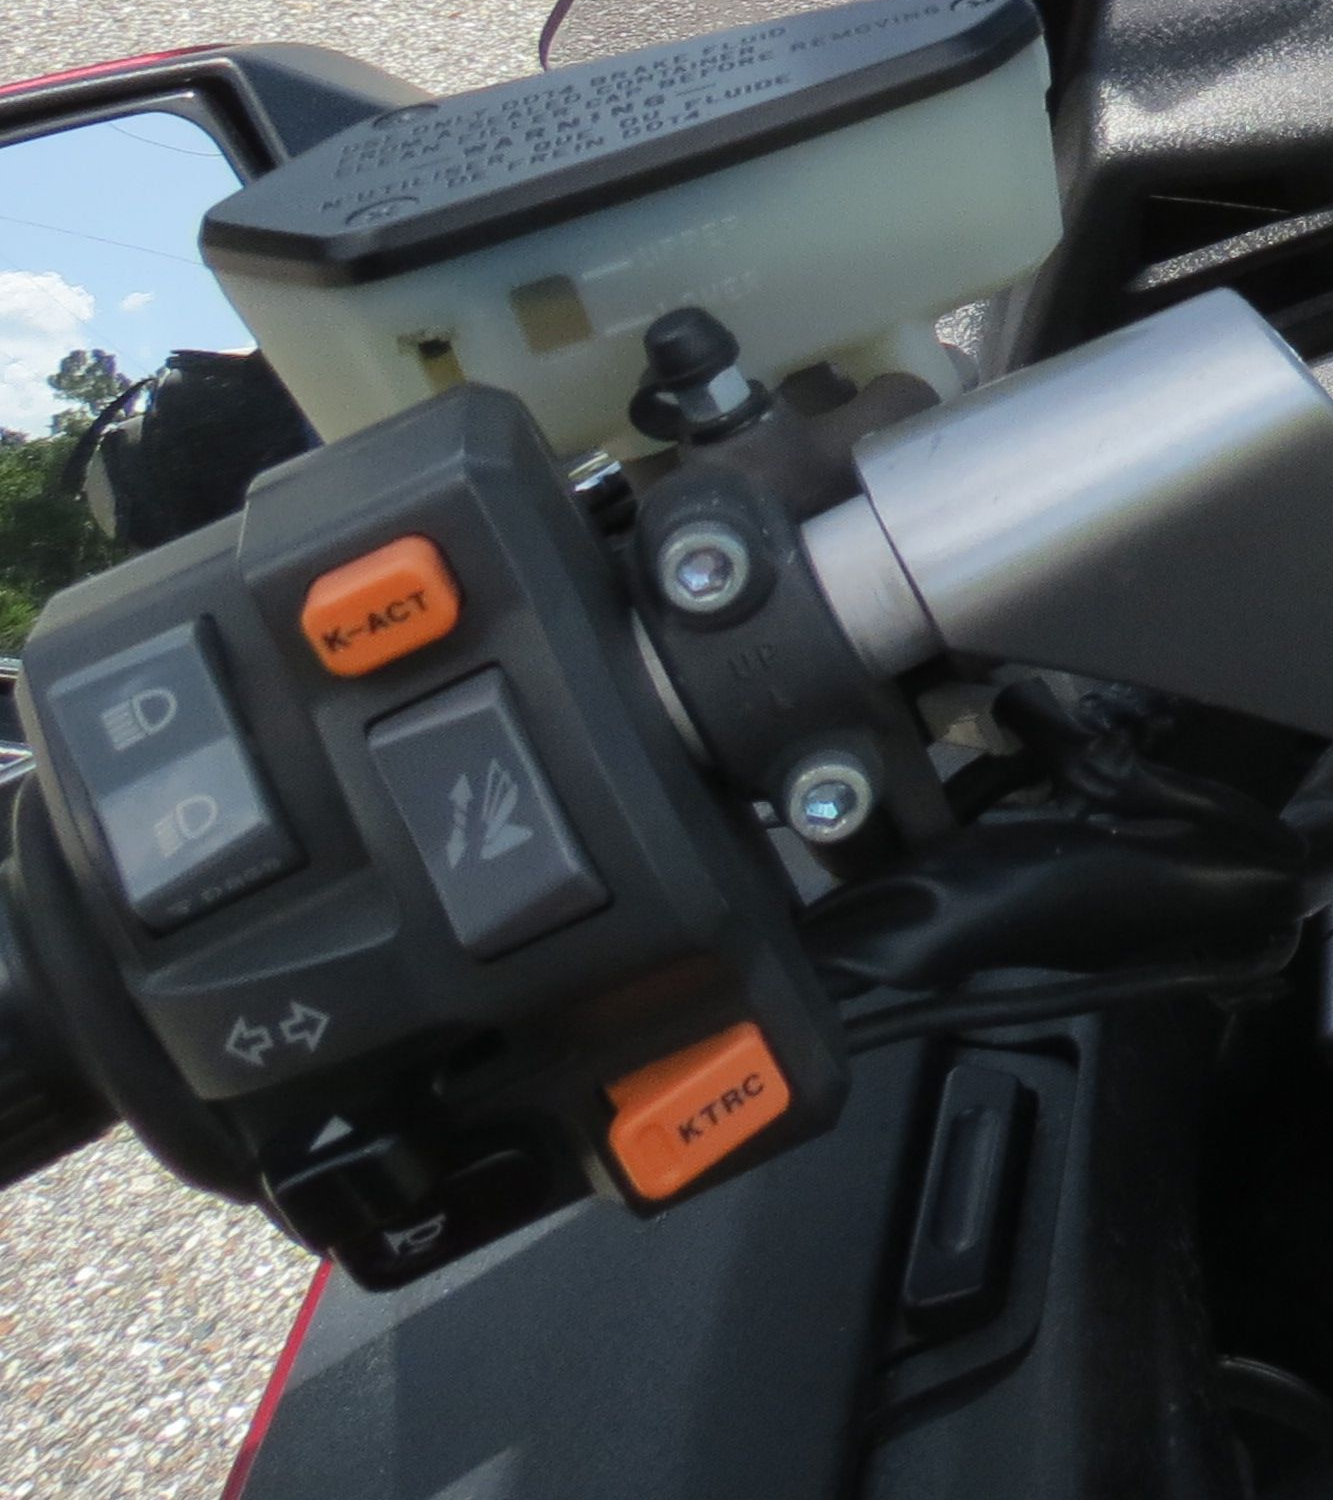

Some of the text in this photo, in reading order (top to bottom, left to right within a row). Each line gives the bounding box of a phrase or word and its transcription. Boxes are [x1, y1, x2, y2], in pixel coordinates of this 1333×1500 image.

[701, 24, 785, 58] FLUID
[790, 3, 940, 52] REMOVING
[320, 587, 433, 654] K-ACT
[675, 1069, 768, 1146] KTRC
